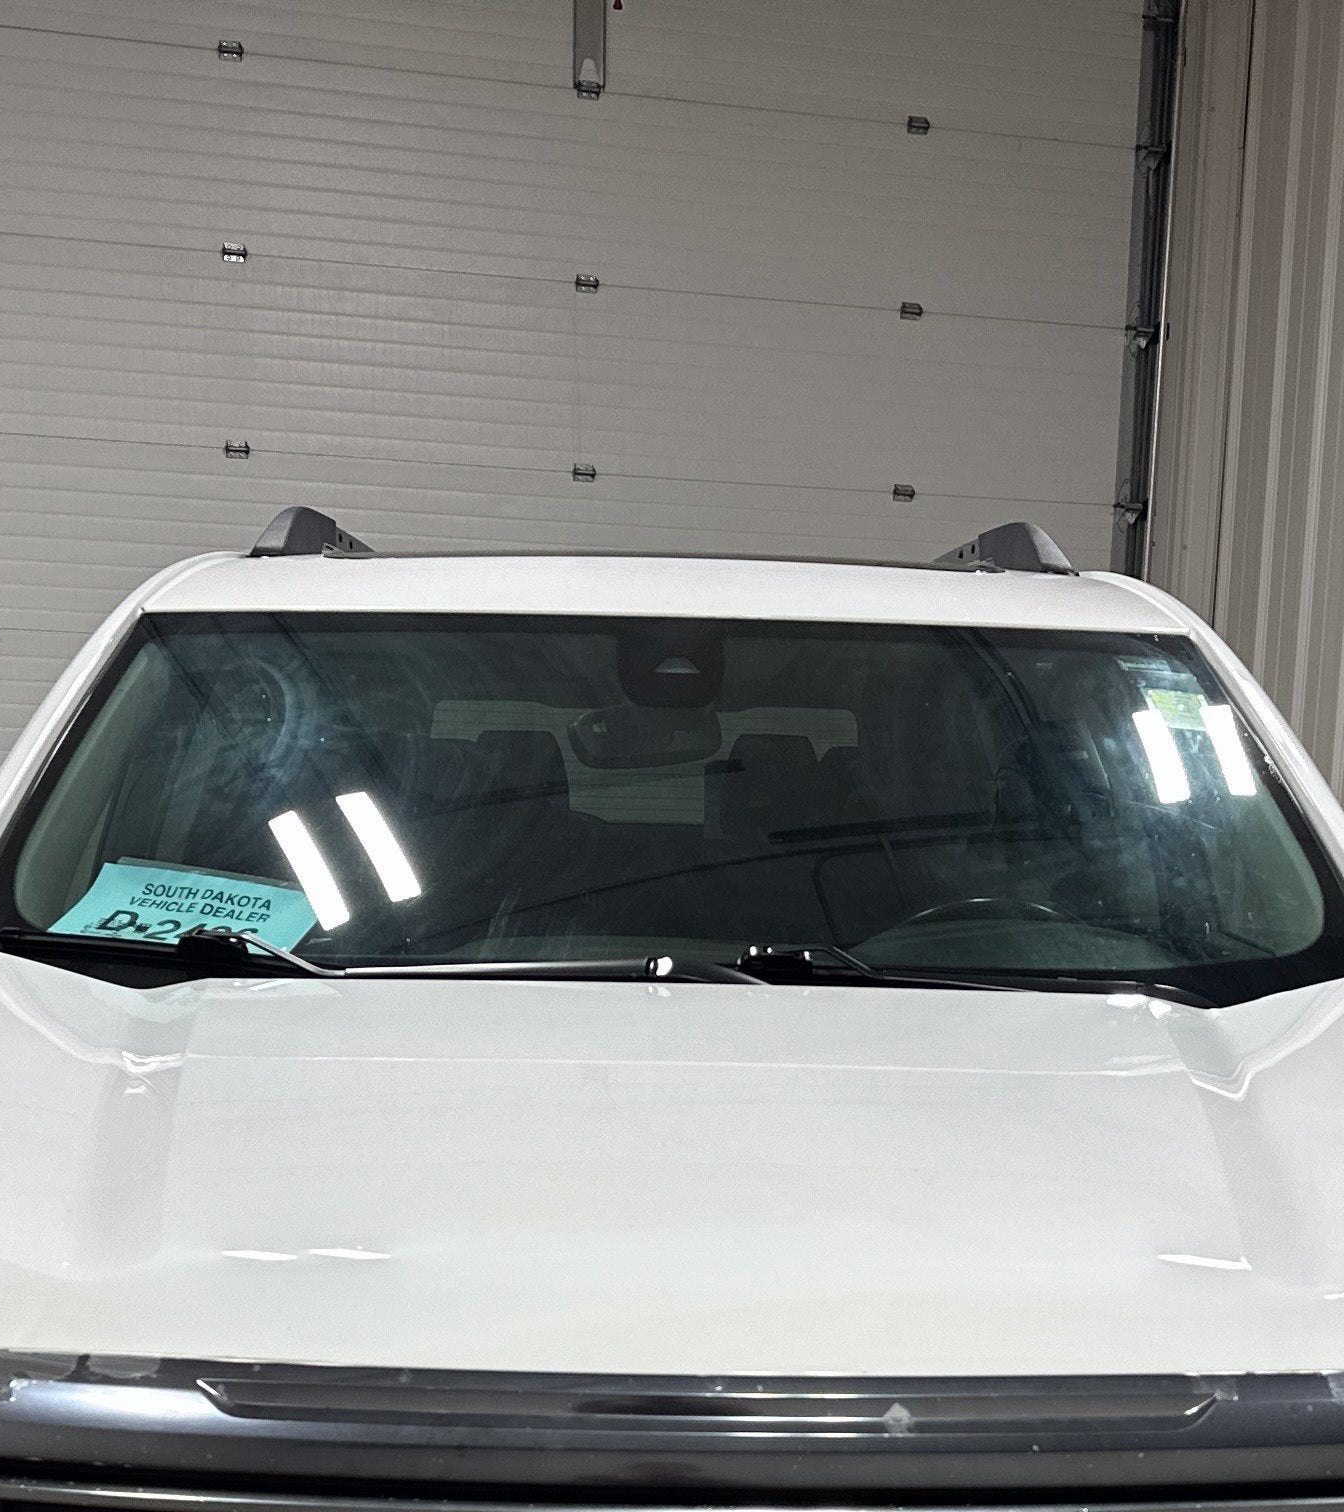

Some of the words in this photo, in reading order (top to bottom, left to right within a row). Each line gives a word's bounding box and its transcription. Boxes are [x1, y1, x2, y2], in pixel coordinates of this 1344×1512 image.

[129, 896, 197, 912] VEHICLE
[200, 904, 271, 923] DEALER
[142, 883, 199, 900] SOUTH
[201, 889, 272, 912] DAKOTA
